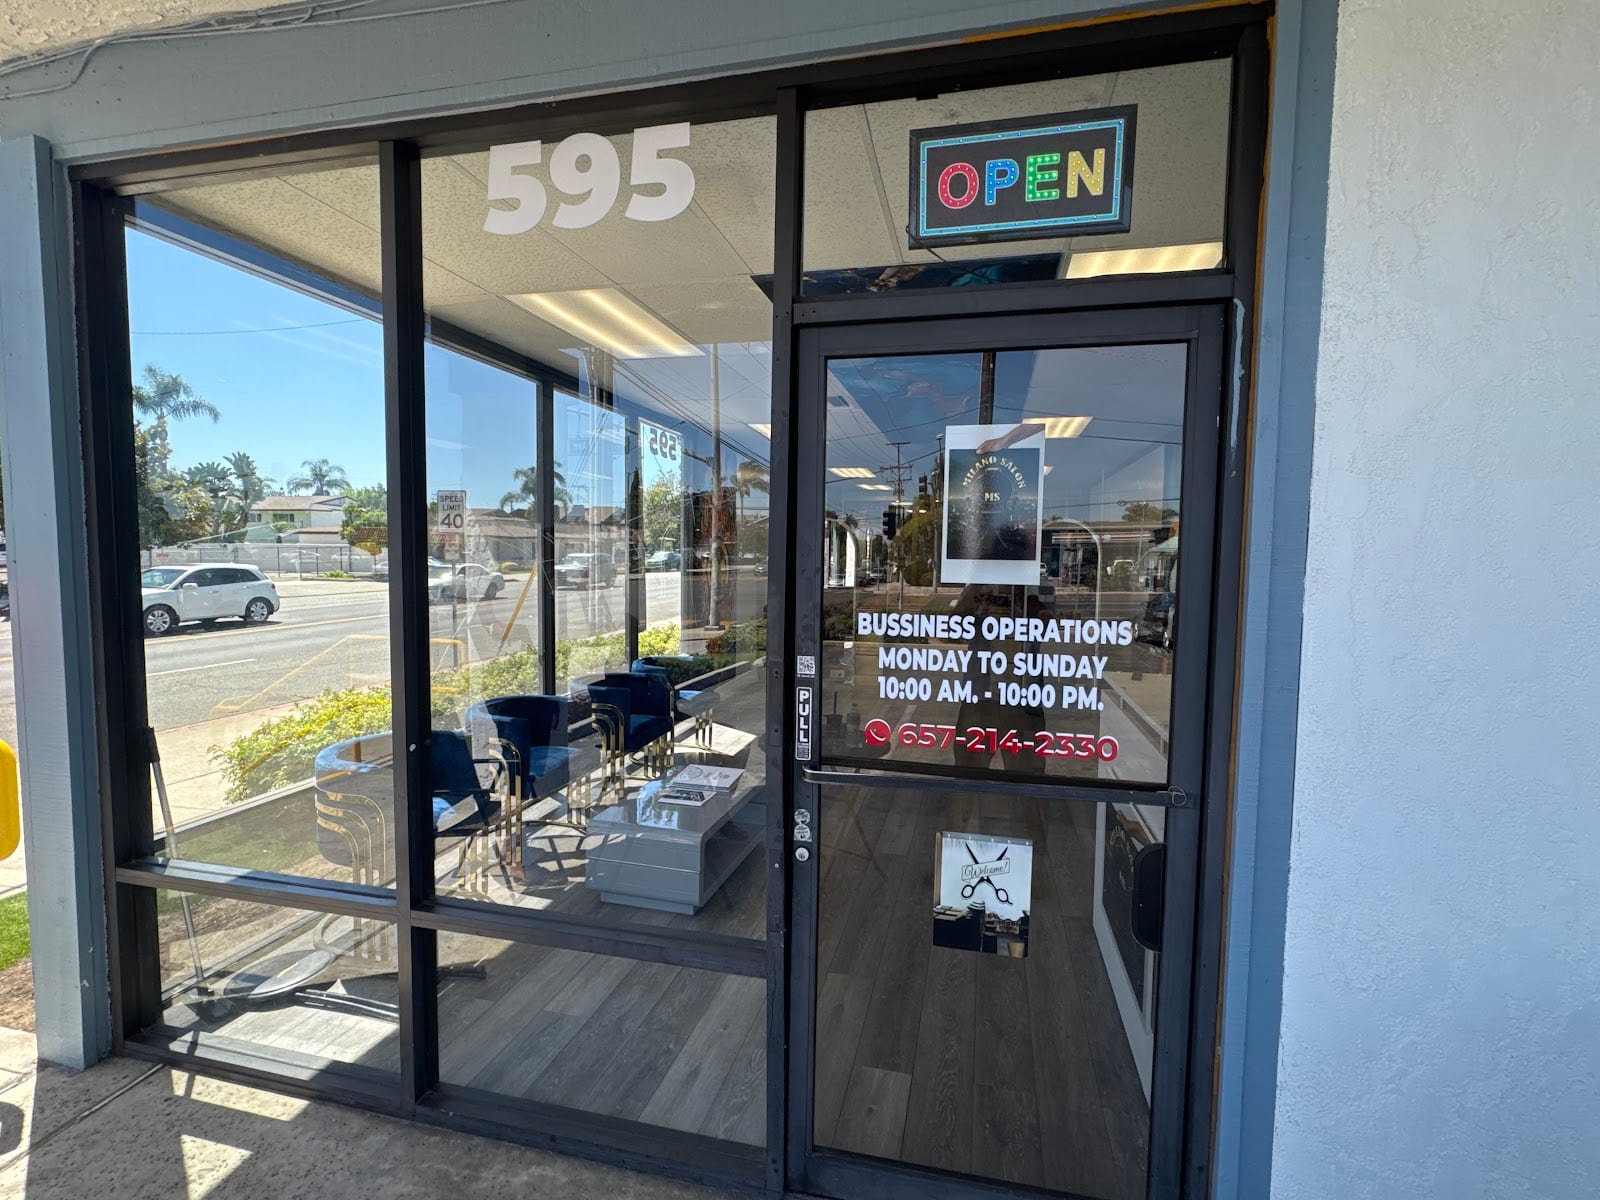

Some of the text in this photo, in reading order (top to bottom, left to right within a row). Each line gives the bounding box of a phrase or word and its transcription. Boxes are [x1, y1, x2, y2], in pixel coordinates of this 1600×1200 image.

[482, 121, 696, 235] 595
[937, 148, 1106, 210] OPEN
[962, 455, 1028, 490] MILANO SALON
[439, 495, 464, 503] SPEED
[984, 492, 1001, 502] MS
[440, 513, 464, 529] 40
[857, 612, 1133, 646] BUSSINESS OPERATIONS
[878, 647, 1108, 680] MONDAY TO SUNDAY
[878, 676, 1105, 711] 10:00 AM. - 10:00 PM.
[798, 690, 810, 743] PULL
[897, 723, 1120, 762] 657-214-2330
[964, 861, 1008, 878] Welcome!
